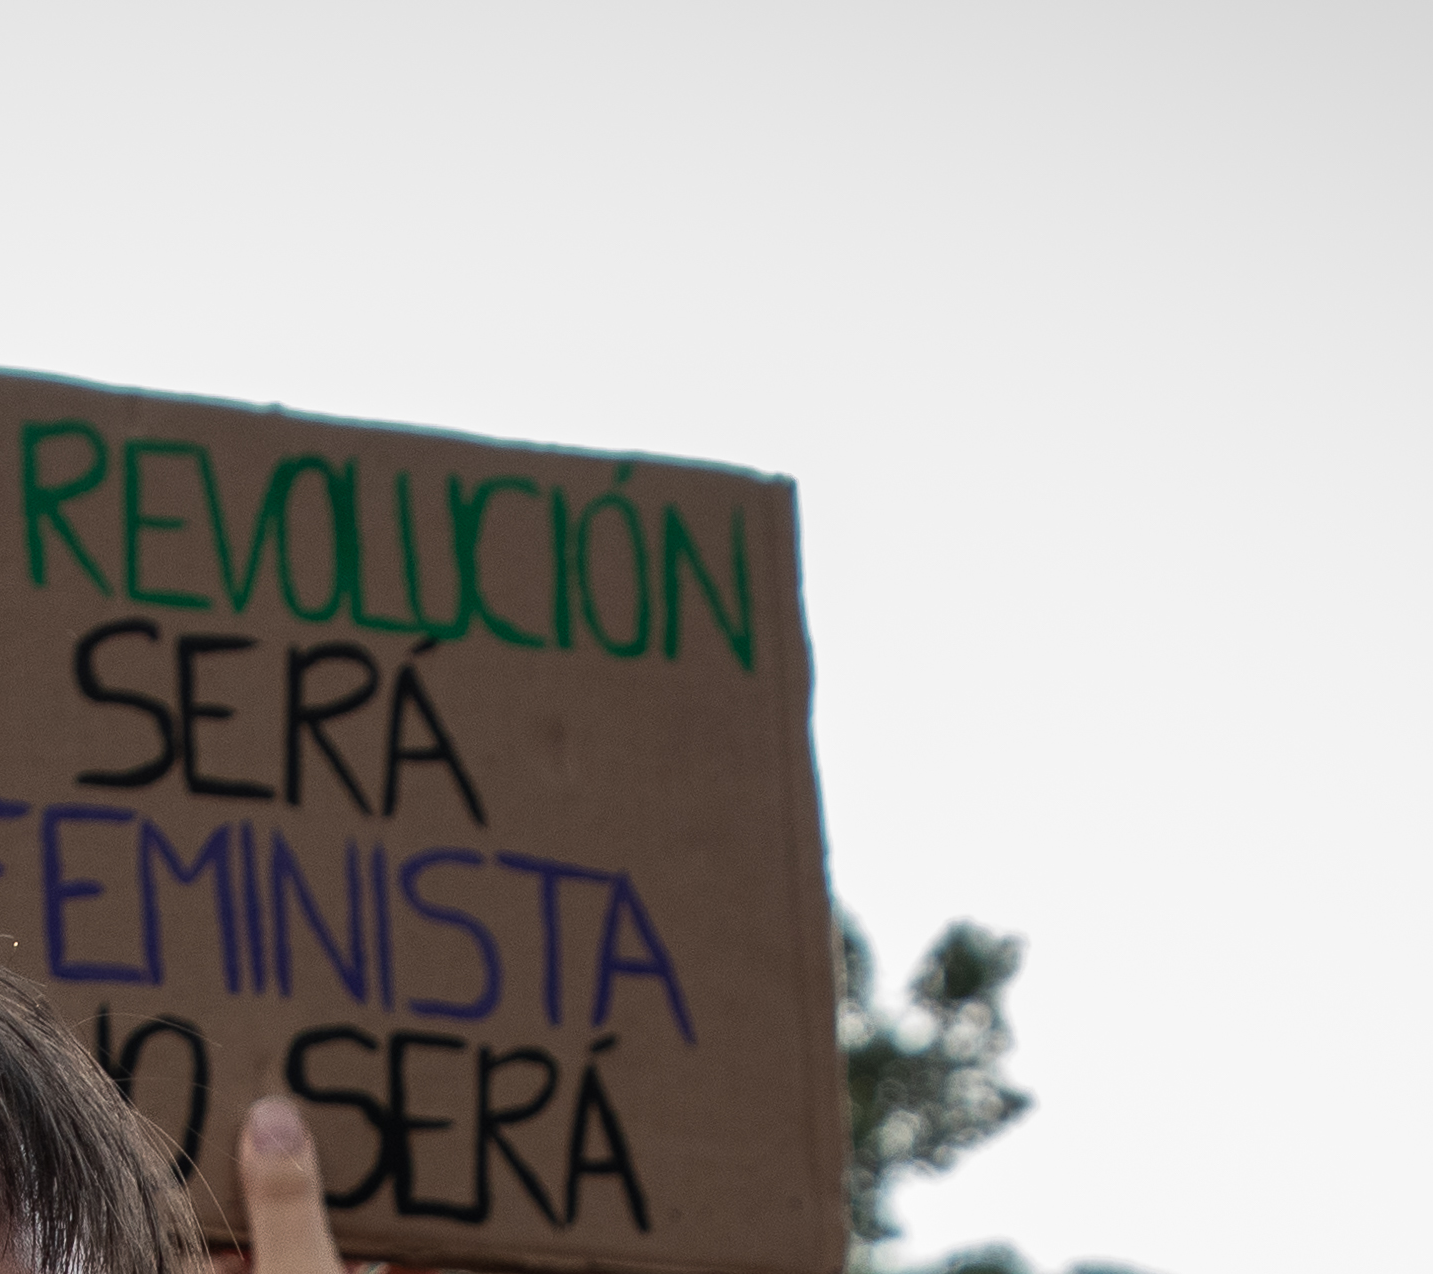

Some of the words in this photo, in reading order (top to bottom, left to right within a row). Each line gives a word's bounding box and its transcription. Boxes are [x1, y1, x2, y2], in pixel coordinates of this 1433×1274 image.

[20, 420, 756, 672] REVOLUCIÓN
[72, 616, 486, 828] SERÁ
[282, 1024, 650, 1234] SERÁ
